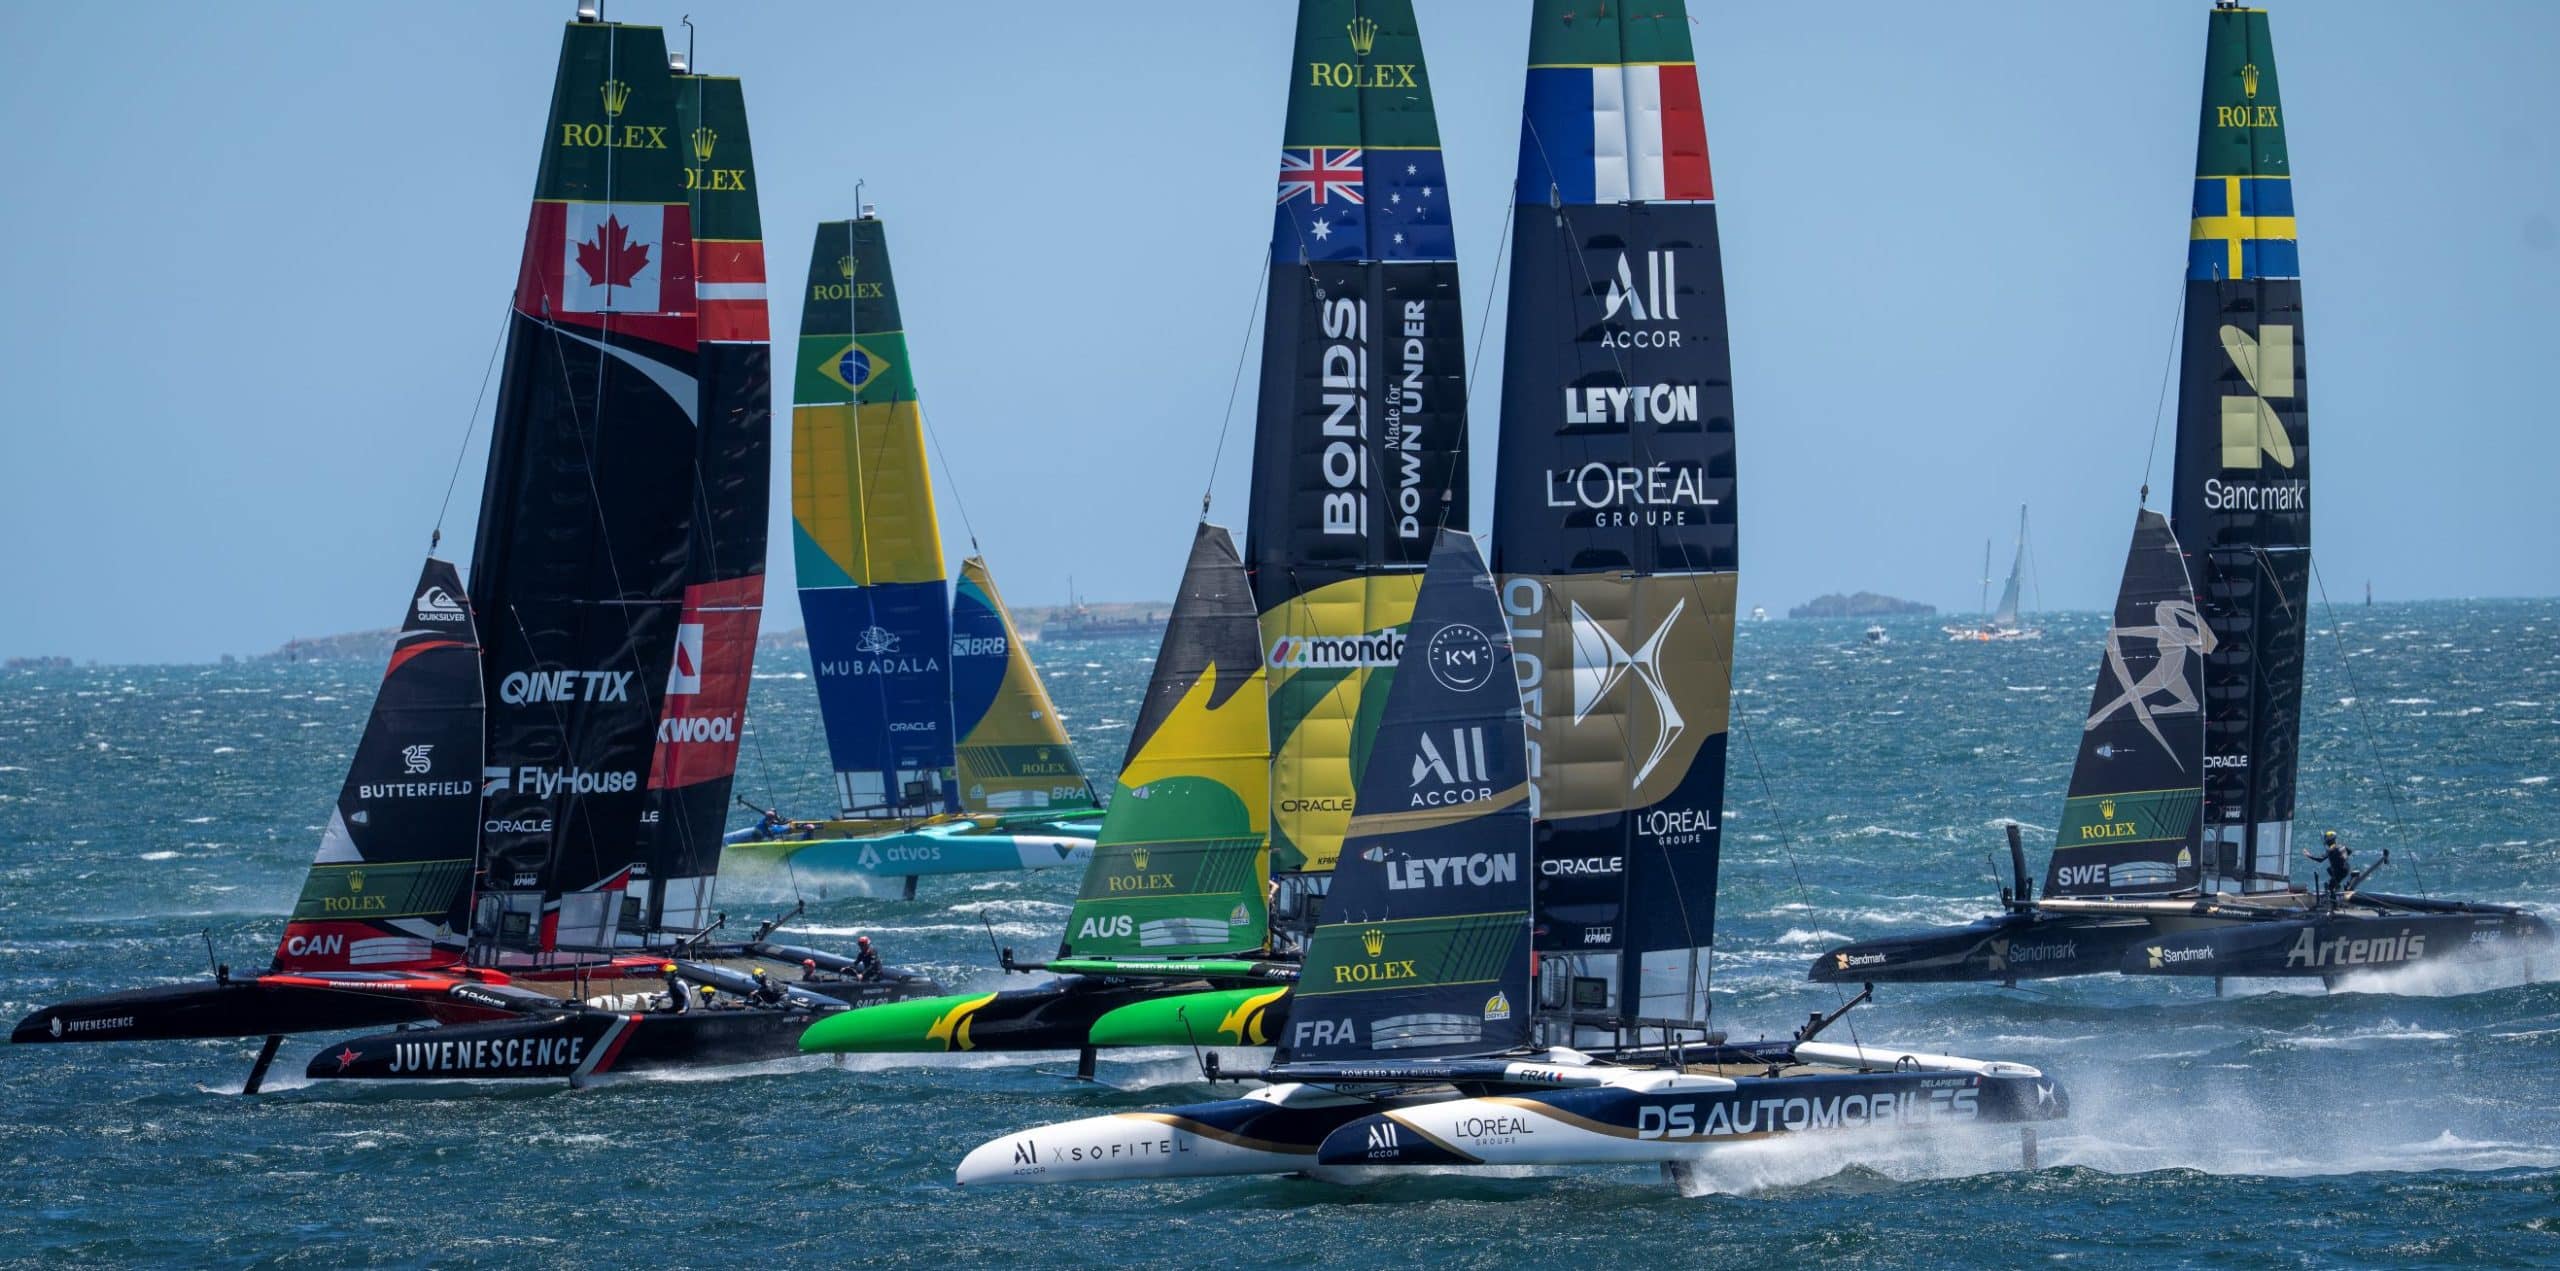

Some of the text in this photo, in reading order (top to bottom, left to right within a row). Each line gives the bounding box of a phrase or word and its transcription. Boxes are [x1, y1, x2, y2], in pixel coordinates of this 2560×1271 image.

[1310, 63, 1418, 88] ROLEX
[2216, 106, 2278, 127] ROLEX
[562, 124, 668, 149] ROLEX
[813, 282, 884, 299] ROLEX
[1601, 331, 1681, 348] ACCOR
[1322, 297, 1357, 534] BONDS
[1385, 384, 1400, 451] Made for
[1400, 300, 1425, 539] DOWN UNDER
[1547, 462, 1719, 508] L'ORÉAL
[1596, 511, 1685, 526] GROUPE
[418, 612, 465, 621] QUIKSILVER
[970, 636, 1005, 656] BRB
[821, 657, 939, 676] MUBADALA
[1445, 650, 1477, 666] KM
[500, 670, 635, 707] QINETIX
[889, 721, 937, 732] ORACLE
[1022, 762, 1065, 775] ROLEX
[2203, 755, 2248, 768] ORACLE
[360, 780, 472, 798] BUTTERFIELD
[518, 767, 637, 799] FlyHouse
[1052, 785, 1087, 799] BRA
[1282, 799, 1352, 812] ORACLE
[1411, 788, 1492, 806] ACCOR
[485, 819, 552, 834] ORACLE
[2080, 822, 2136, 839] ROLEX
[1659, 834, 1701, 845] GROUPE
[888, 846, 941, 861] atvos
[1540, 857, 1624, 876] ORACLE
[2058, 864, 2107, 886] SWE
[1109, 873, 1175, 891] ROLEX
[324, 894, 387, 914] ROLEX
[1078, 914, 1133, 939] AUS
[288, 934, 344, 956] CAN
[1584, 931, 1613, 943] KPMG
[2009, 939, 2078, 962] Sandmark
[2164, 945, 2214, 962] Sandmark
[2287, 927, 2426, 968] Artemis
[1849, 954, 1886, 965] Sandmark
[1334, 960, 1417, 983] ROLEX
[67, 1015, 134, 1032] JUVENESCENCE
[1293, 1018, 1356, 1048] FRA
[389, 1037, 583, 1072] JUVENESCENCE
[1341, 1069, 1387, 1077] POWERED
[1520, 1070, 1548, 1081] FRA
[1639, 1088, 1979, 1140] DS AUTOMOBILES
[1072, 1138, 1190, 1162] SOFITEL
[1368, 1148, 1399, 1159] ACCOR
